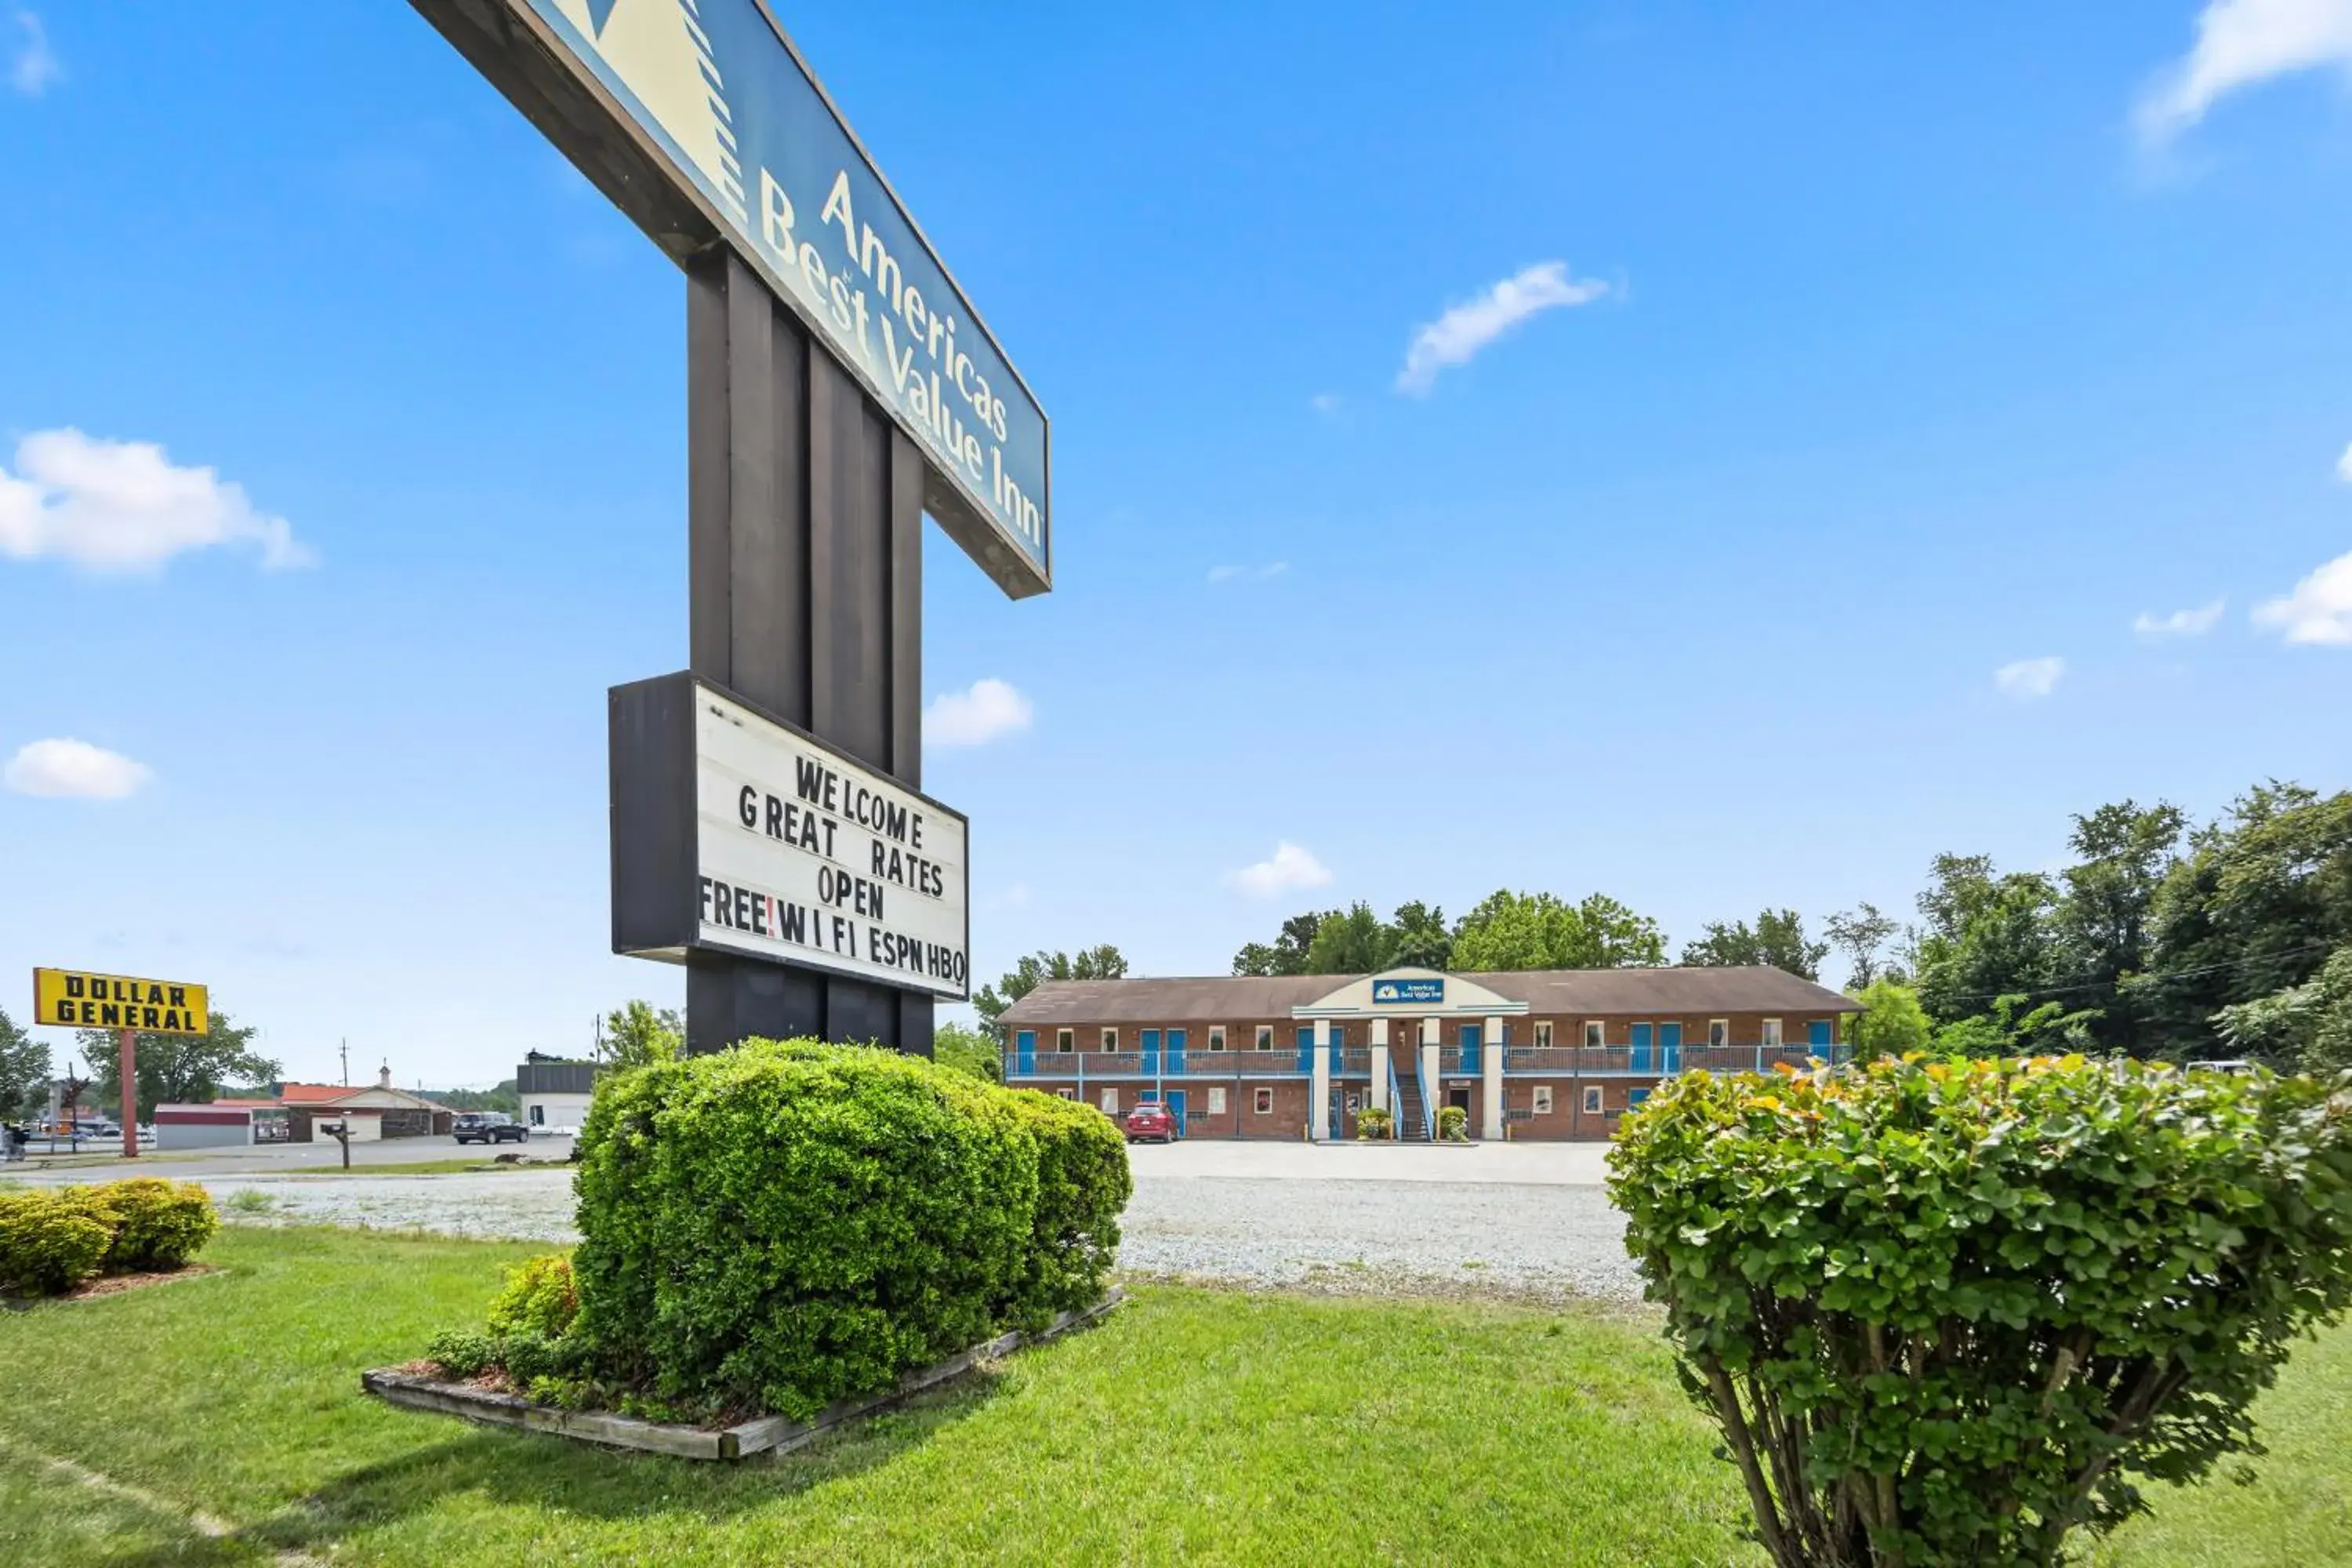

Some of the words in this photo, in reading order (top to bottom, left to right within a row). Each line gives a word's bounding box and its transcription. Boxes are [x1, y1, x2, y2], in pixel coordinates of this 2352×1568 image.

[821, 169, 1007, 443] Americas
[760, 166, 869, 358] Best
[880, 313, 983, 481] Value
[992, 446, 1040, 547] Inn
[796, 756, 923, 849] WELCOME
[739, 785, 837, 857] GREAT
[872, 839, 943, 897] RATES
[818, 865, 884, 922] OPEN
[65, 975, 186, 1007] DOLLAR
[869, 926, 923, 972] ESPN
[928, 943, 965, 982] HBO
[57, 1000, 197, 1031] GENERAL
